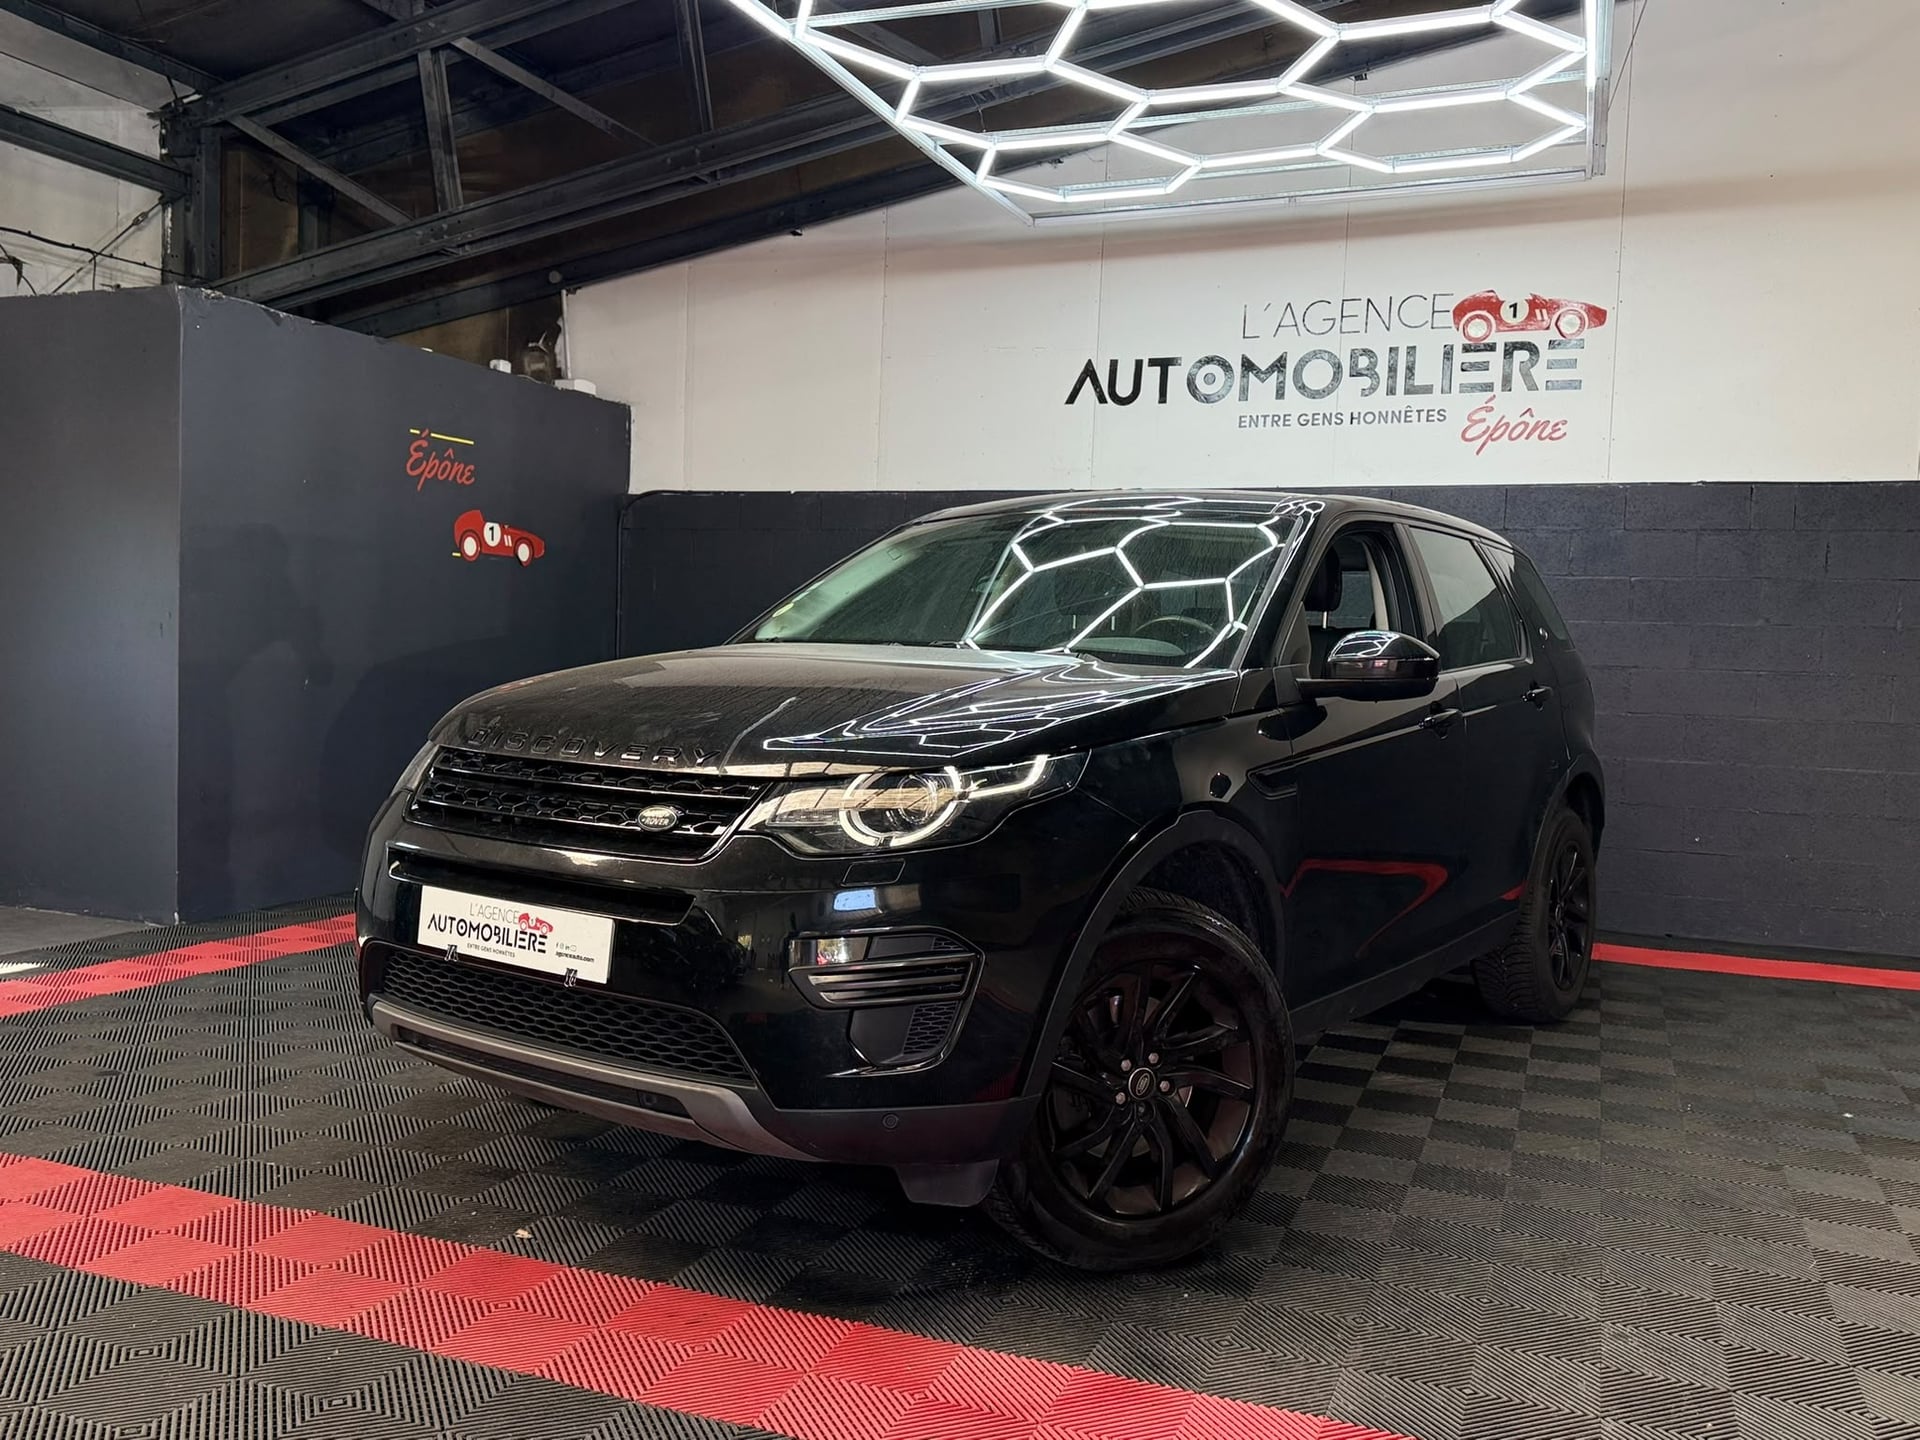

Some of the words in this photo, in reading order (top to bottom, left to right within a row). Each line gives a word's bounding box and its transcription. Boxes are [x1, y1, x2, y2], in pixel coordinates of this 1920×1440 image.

[1242, 292, 1455, 339] L'AGENCE
[1237, 414, 1292, 429] ENTRE
[1297, 411, 1344, 428] GENS
[1349, 404, 1448, 425] HONNÊTES
[1460, 396, 1568, 455] Épône
[406, 428, 475, 491] Épône
[488, 526, 495, 541] 1
[468, 727, 721, 766] DISCOVERY
